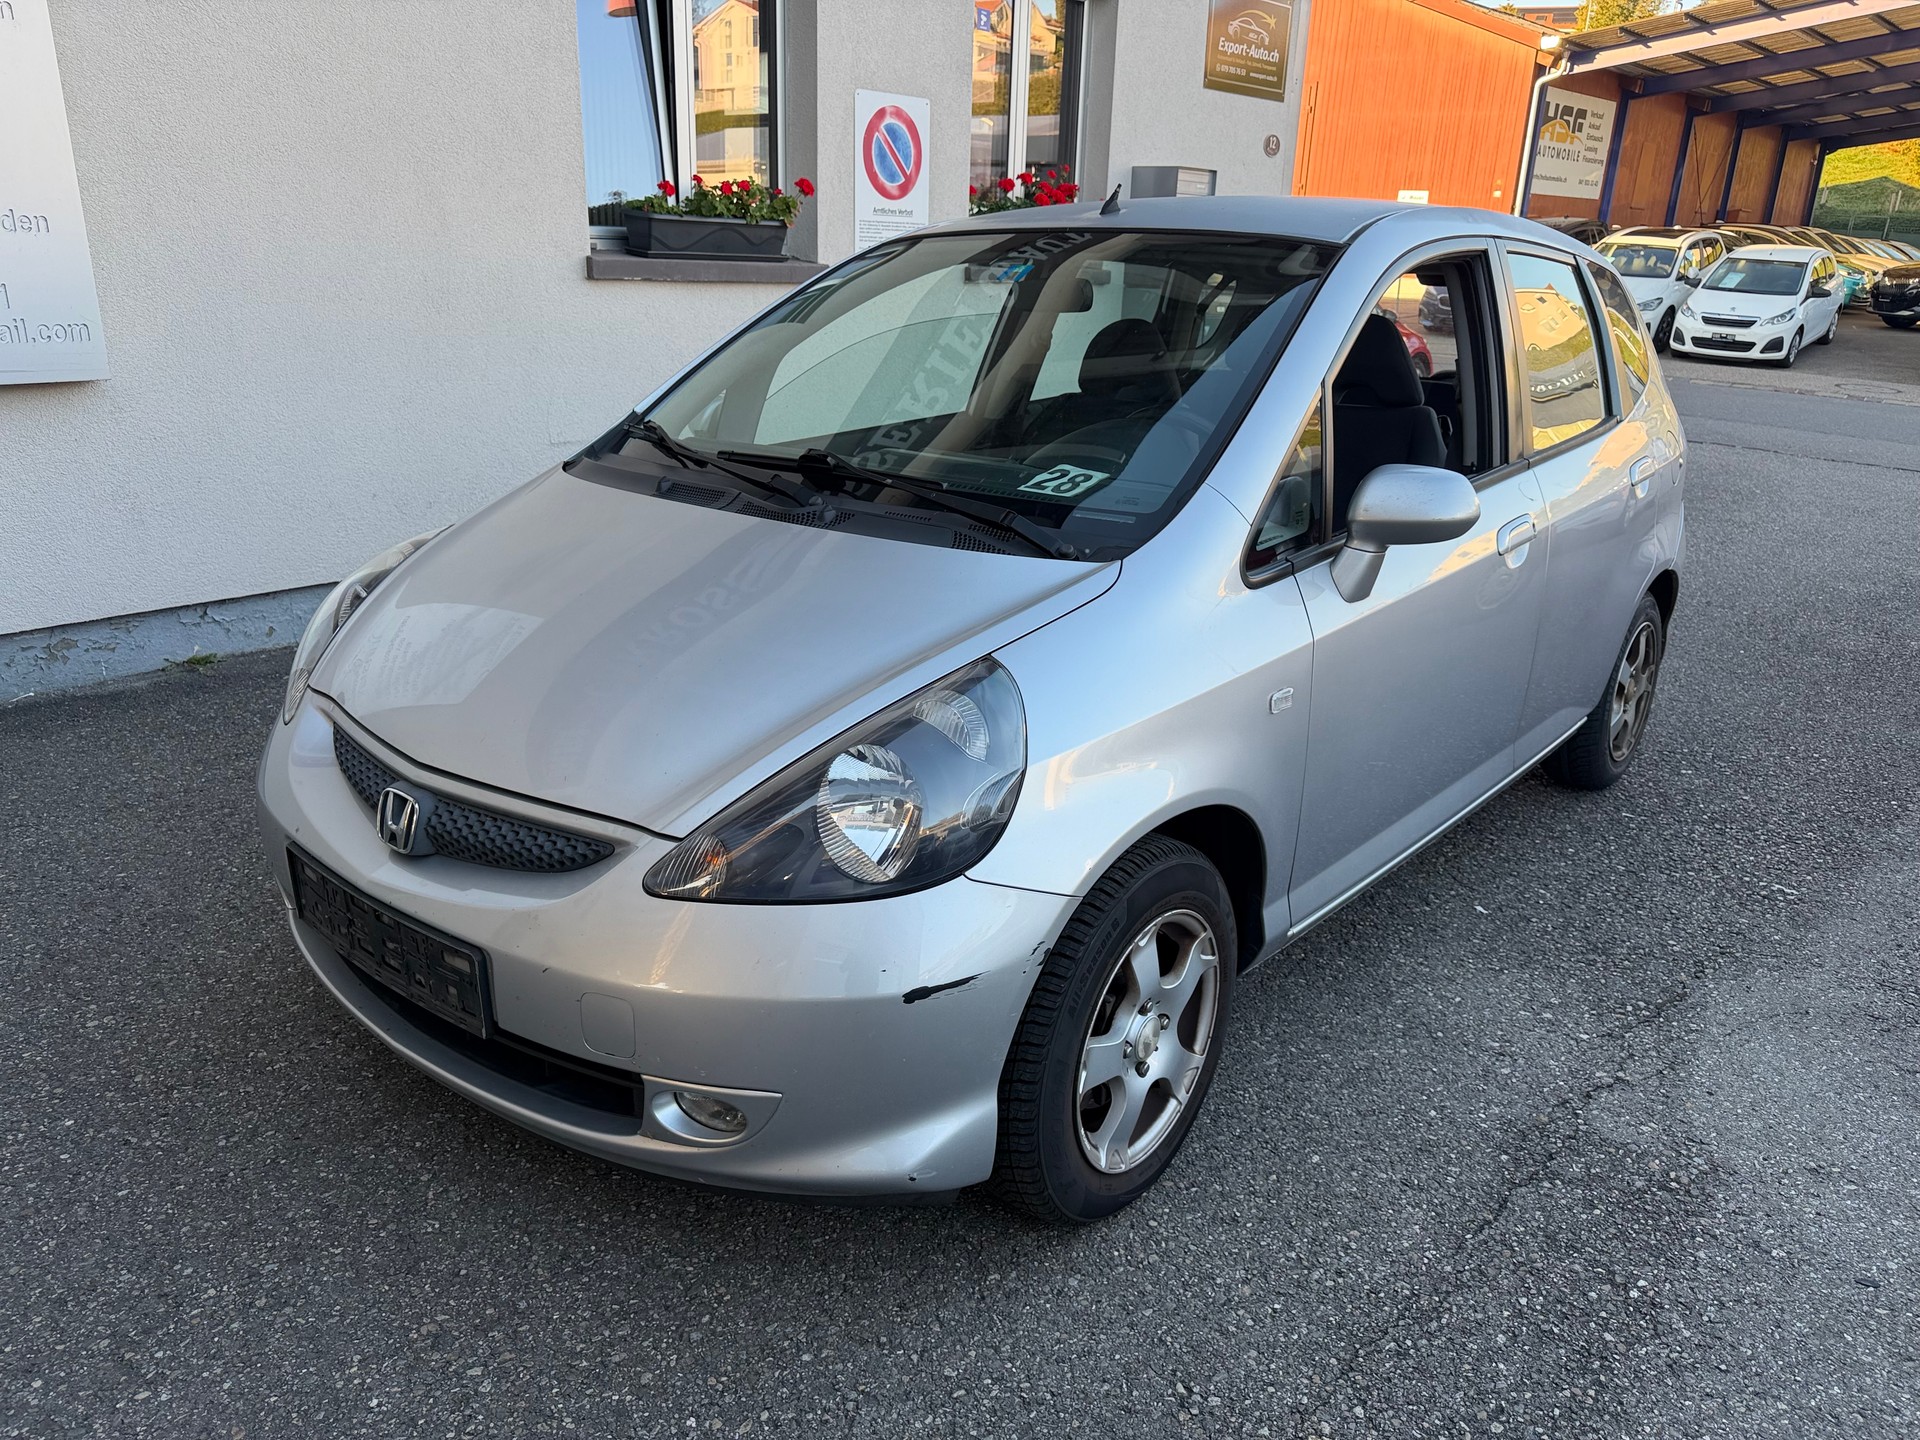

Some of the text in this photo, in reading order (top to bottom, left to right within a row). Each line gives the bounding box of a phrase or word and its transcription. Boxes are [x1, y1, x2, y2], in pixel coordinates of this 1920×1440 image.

[1218, 37, 1279, 63] Export-Auto.ch
[1537, 144, 1580, 162] AUTOMOBILE
[872, 206, 913, 217] Amtliches Verbot
[1025, 468, 1094, 494] 28
